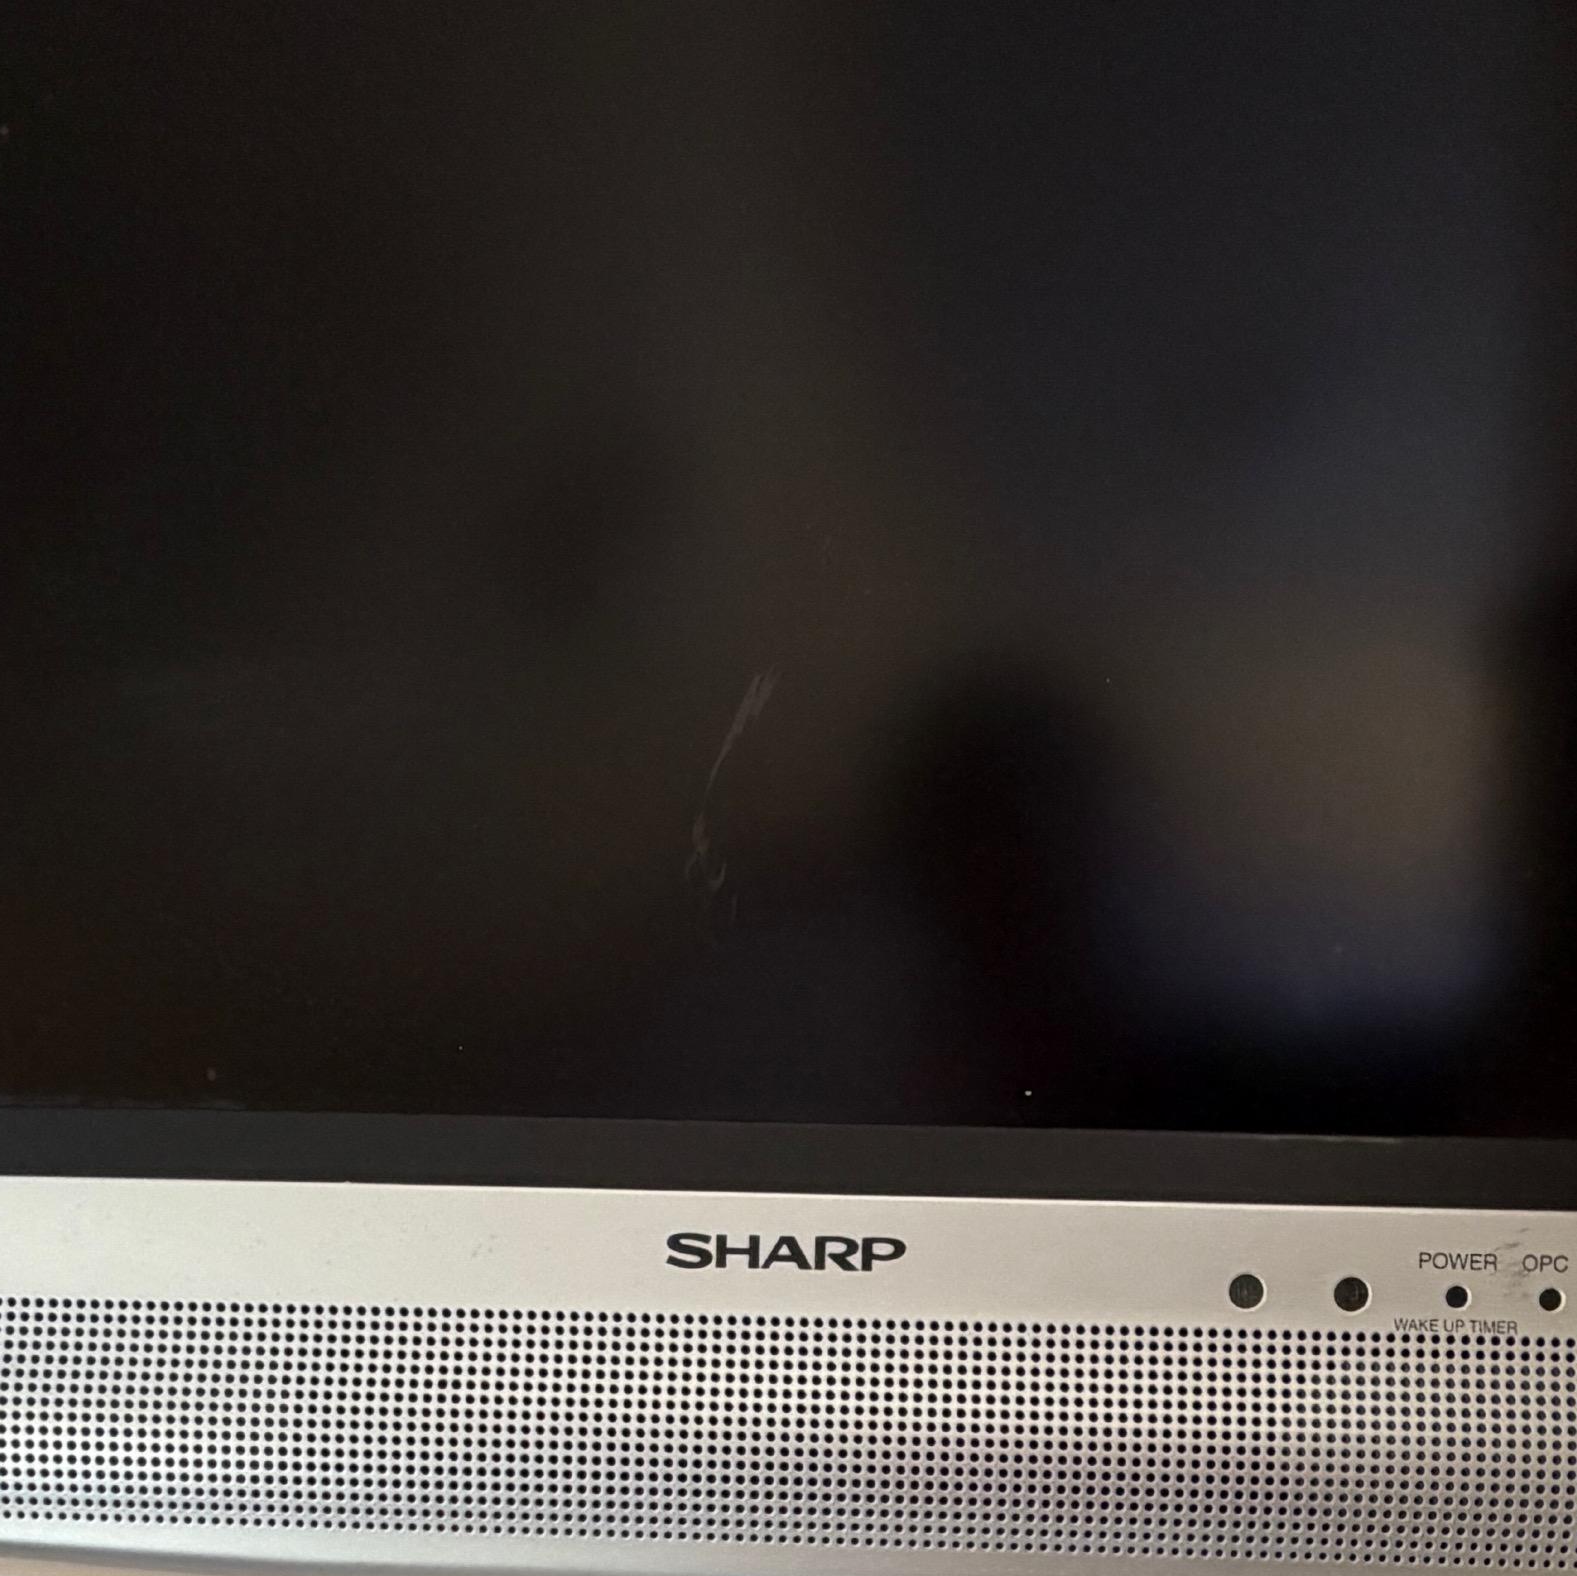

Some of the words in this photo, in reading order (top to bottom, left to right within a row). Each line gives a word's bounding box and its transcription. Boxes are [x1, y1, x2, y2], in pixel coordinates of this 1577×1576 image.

[666, 1232, 907, 1272] SHARP
[1419, 1252, 1498, 1271] POWER
[1522, 1254, 1569, 1273] OPC
[1394, 1318, 1439, 1333] WAKE
[1443, 1319, 1465, 1333] UP
[1469, 1320, 1518, 1335] TIMER
